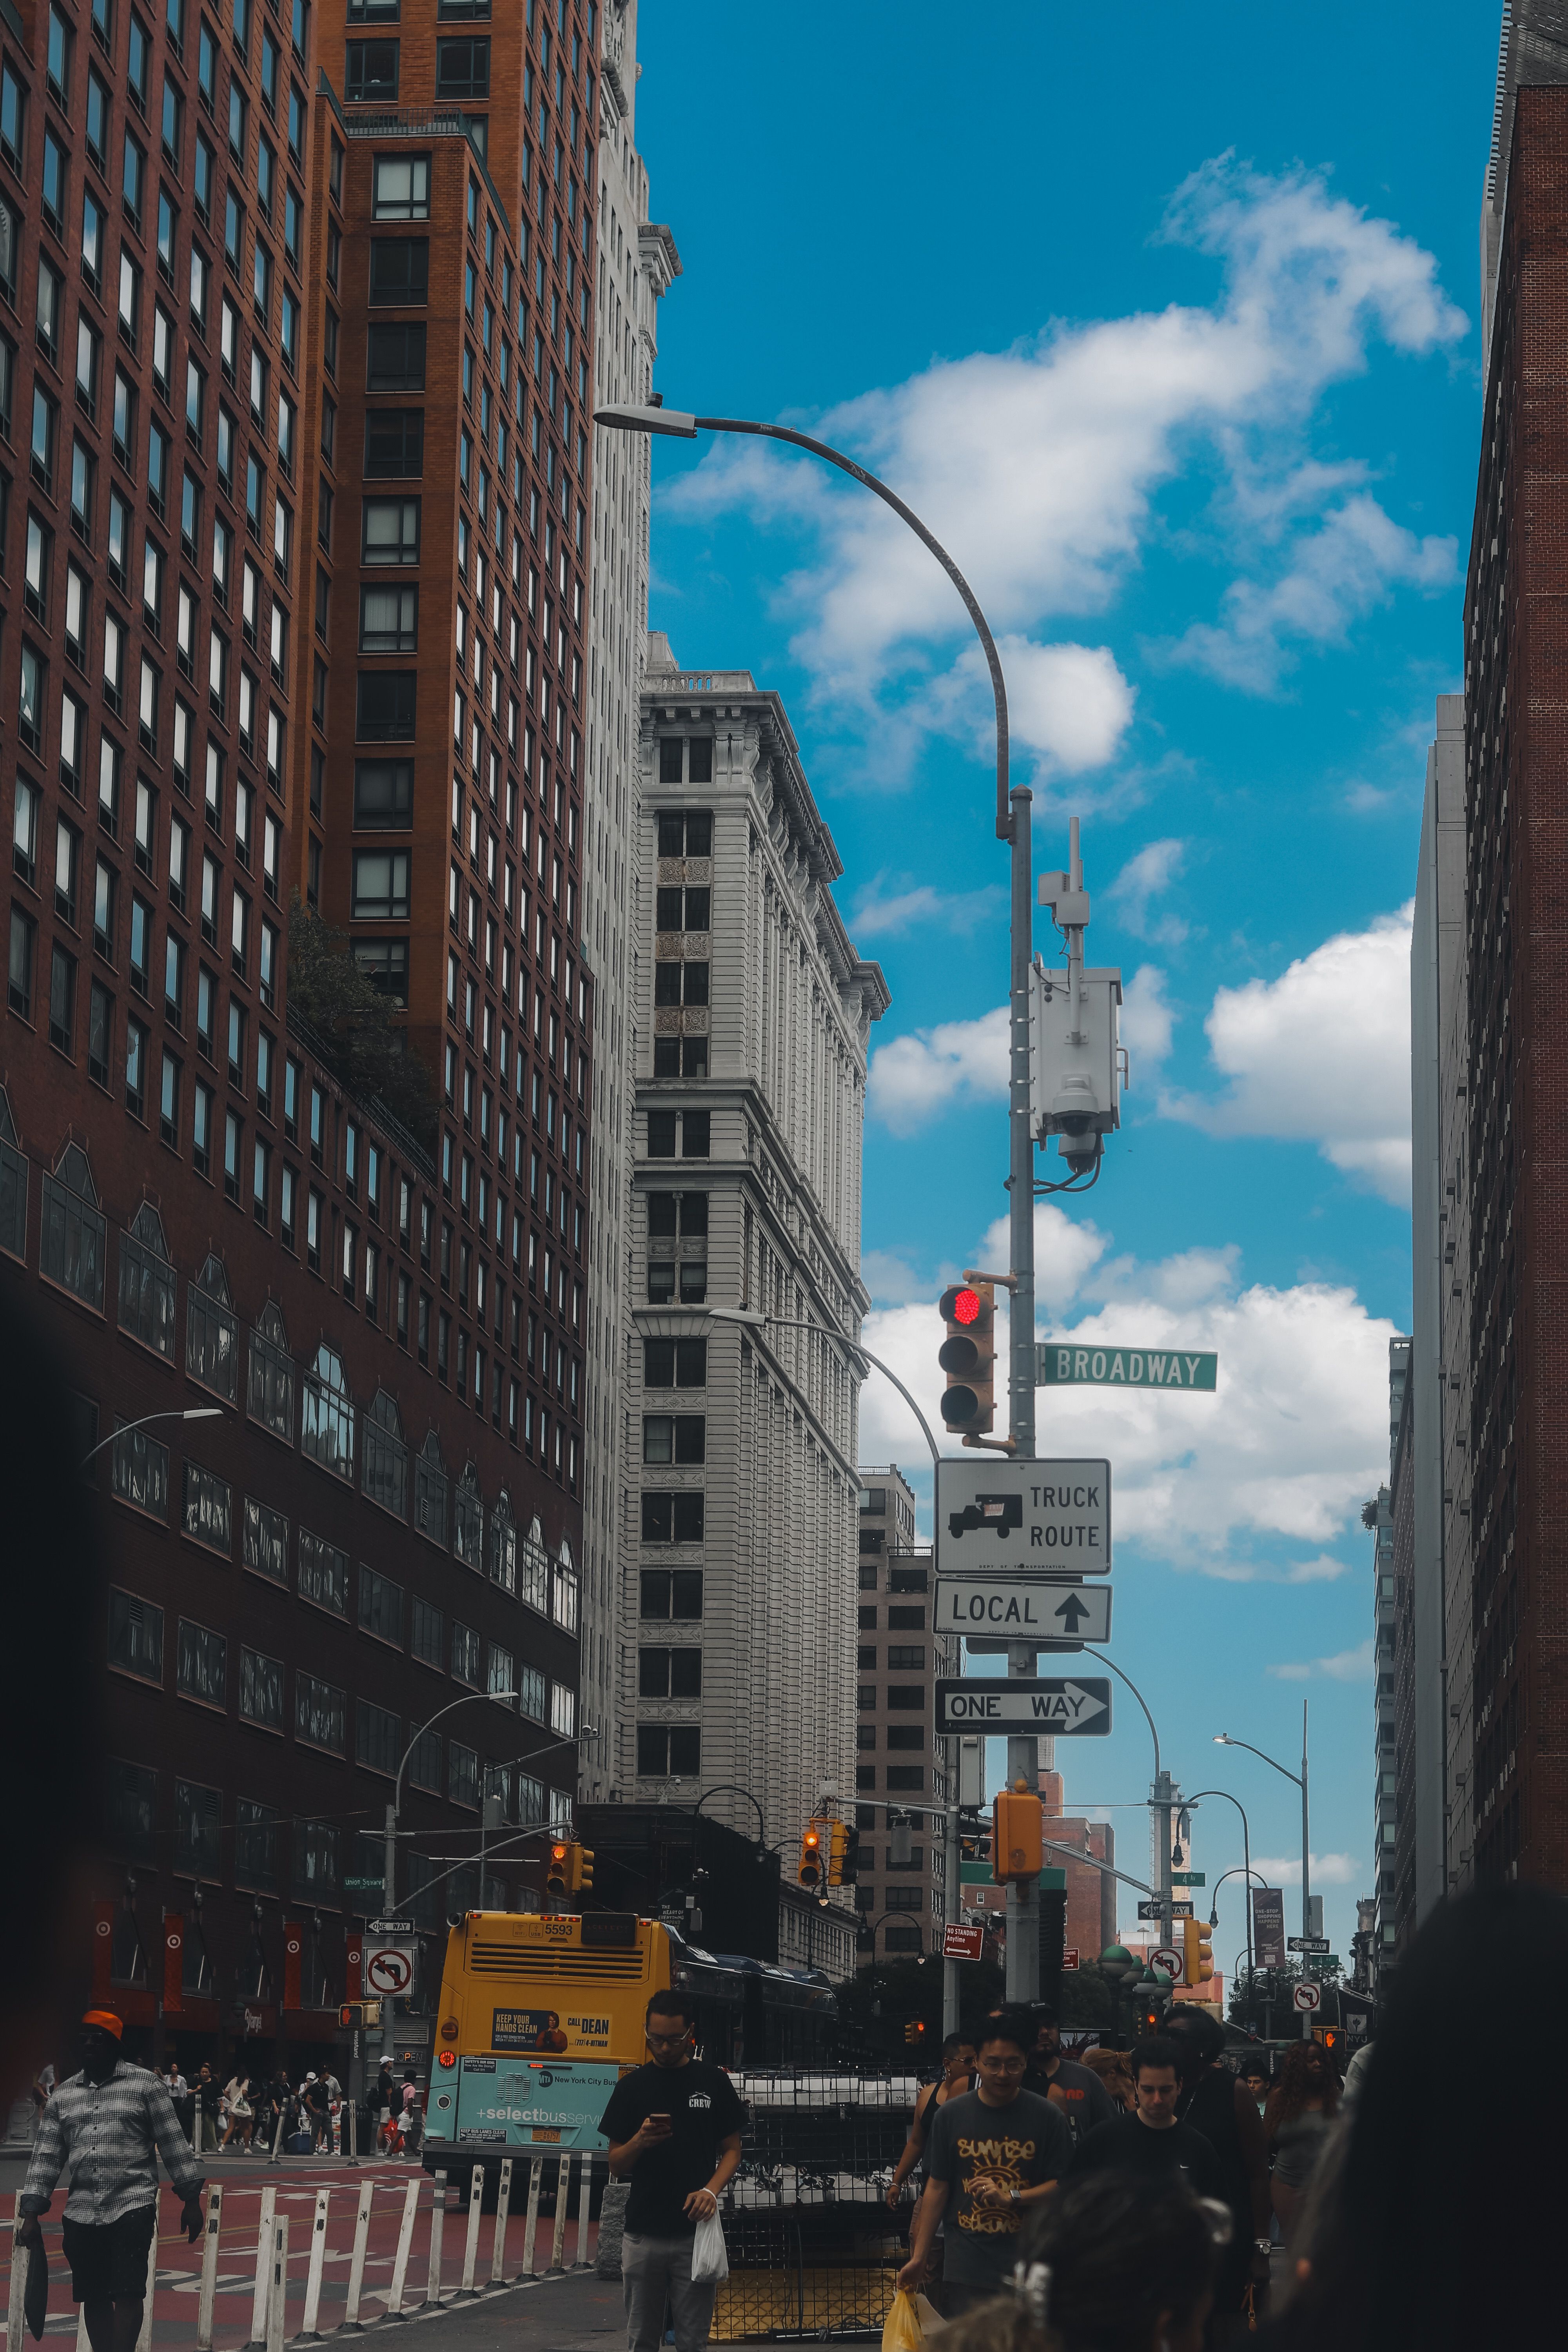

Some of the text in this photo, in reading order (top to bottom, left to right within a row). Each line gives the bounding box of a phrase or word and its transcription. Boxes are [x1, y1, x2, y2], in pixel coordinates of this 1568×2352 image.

[1057, 1350, 1201, 1385] BROADWAY
[1030, 1487, 1099, 1507] TRUCK
[1031, 1526, 1099, 1547] ROUTE
[953, 1594, 1038, 1623] LOCAL
[951, 1696, 1086, 1717] ONE WAY
[1183, 1875, 1187, 1884] 4
[545, 1924, 573, 1935] 5593
[955, 1929, 977, 1937] STANDING
[496, 2014, 530, 2024] KEEP YOUR
[495, 2023, 537, 2034] HANDS CLEAN
[568, 2018, 609, 2035] CALL DEAN
[1347, 2034, 1367, 2043] NYU
[398, 2053, 422, 2062] OPEN
[539, 2074, 552, 2084] MTA
[588, 2078, 602, 2086] City
[689, 2098, 711, 2109] CREW
[957, 2135, 1036, 2160] sunrise
